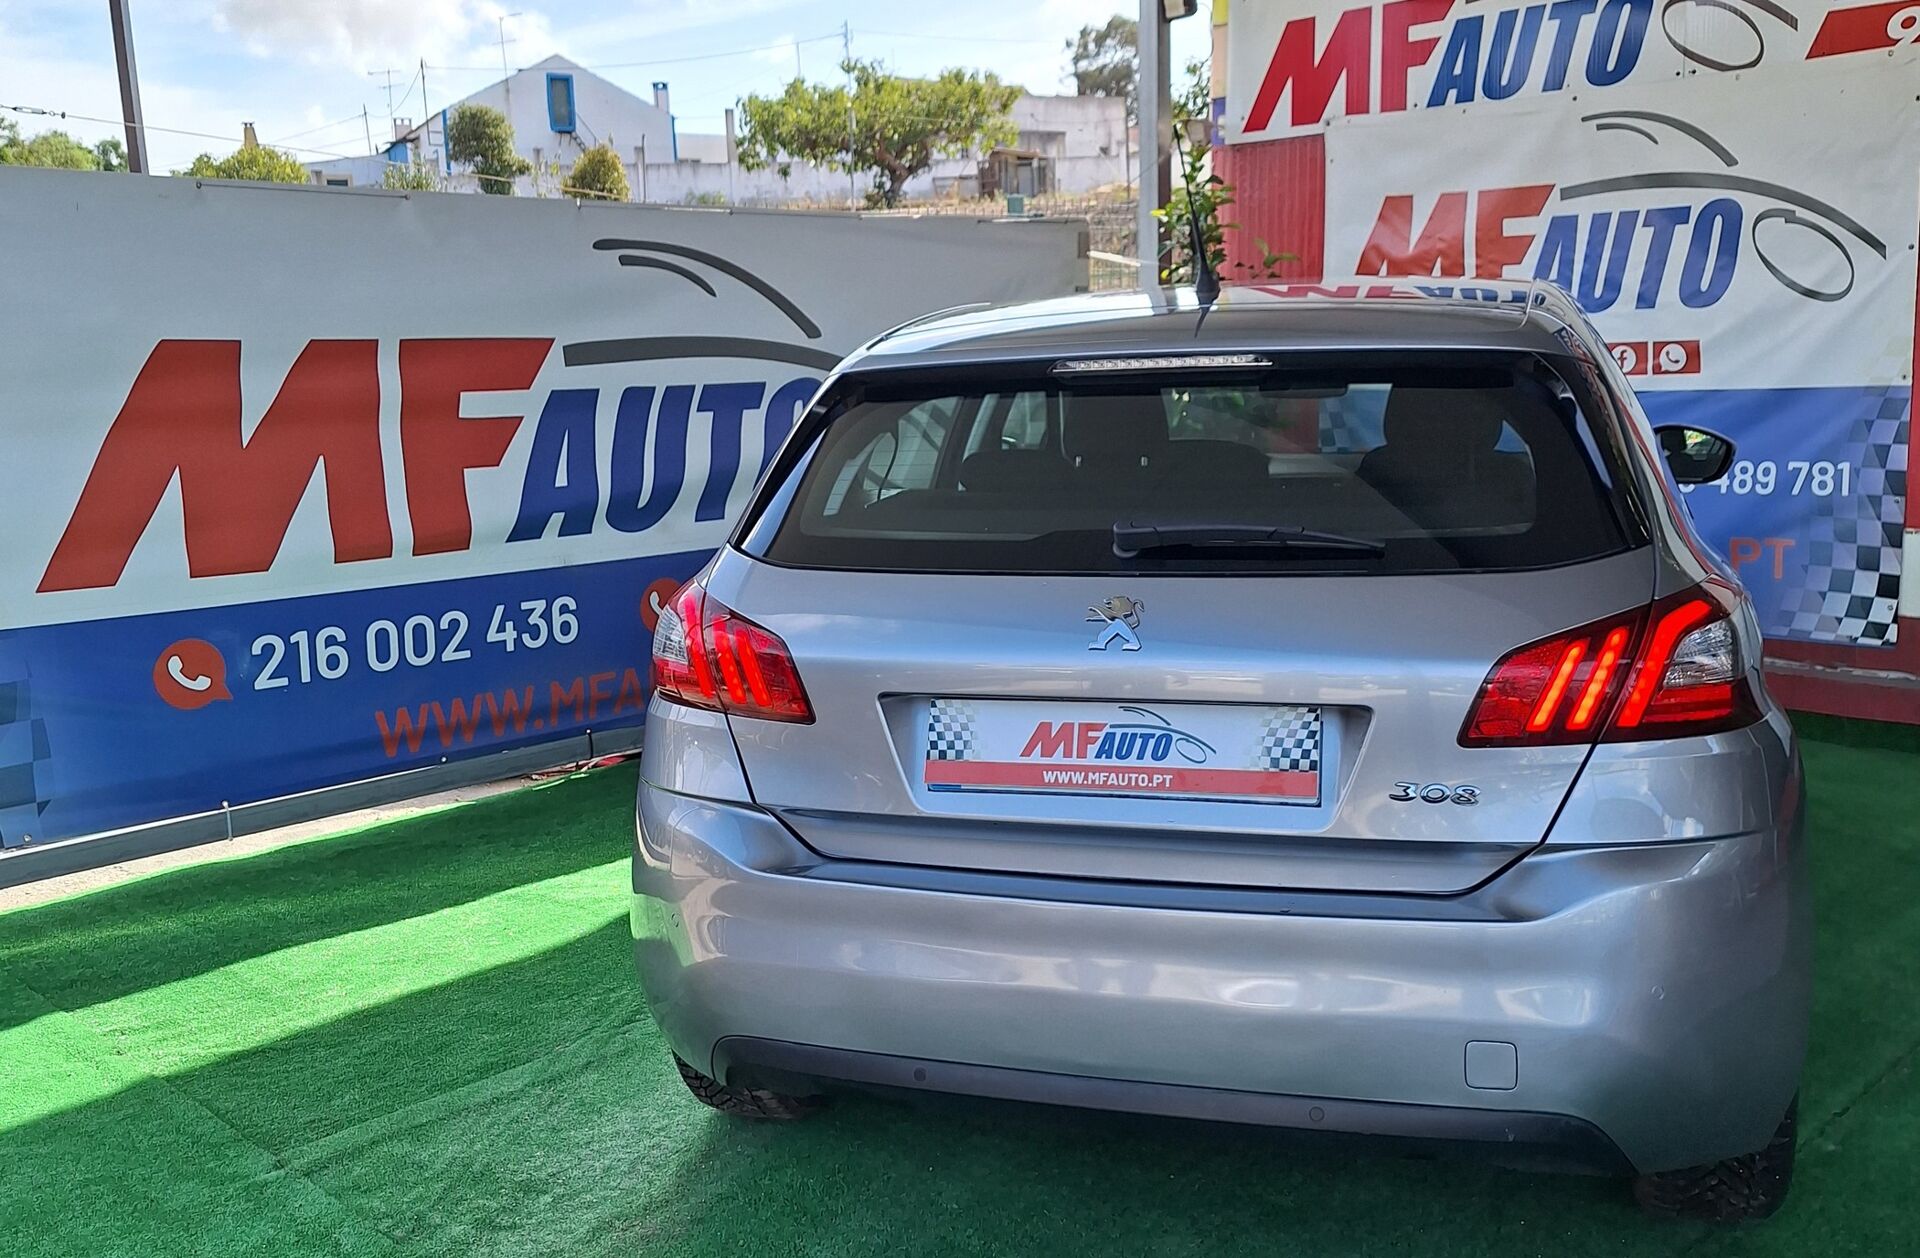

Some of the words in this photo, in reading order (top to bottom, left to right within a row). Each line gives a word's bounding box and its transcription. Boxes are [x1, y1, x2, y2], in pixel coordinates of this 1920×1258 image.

[1242, 0, 1652, 133] MFAUTO
[1788, 460, 1851, 497] 781
[251, 625, 349, 691] 216
[366, 609, 472, 674] 002
[486, 595, 579, 653] 436
[375, 667, 655, 758] WWW.MFA
[1019, 721, 1172, 763] MFAUTO
[1043, 769, 1174, 789] WWW.MFAUTO.PT
[1388, 781, 1481, 806] 308
